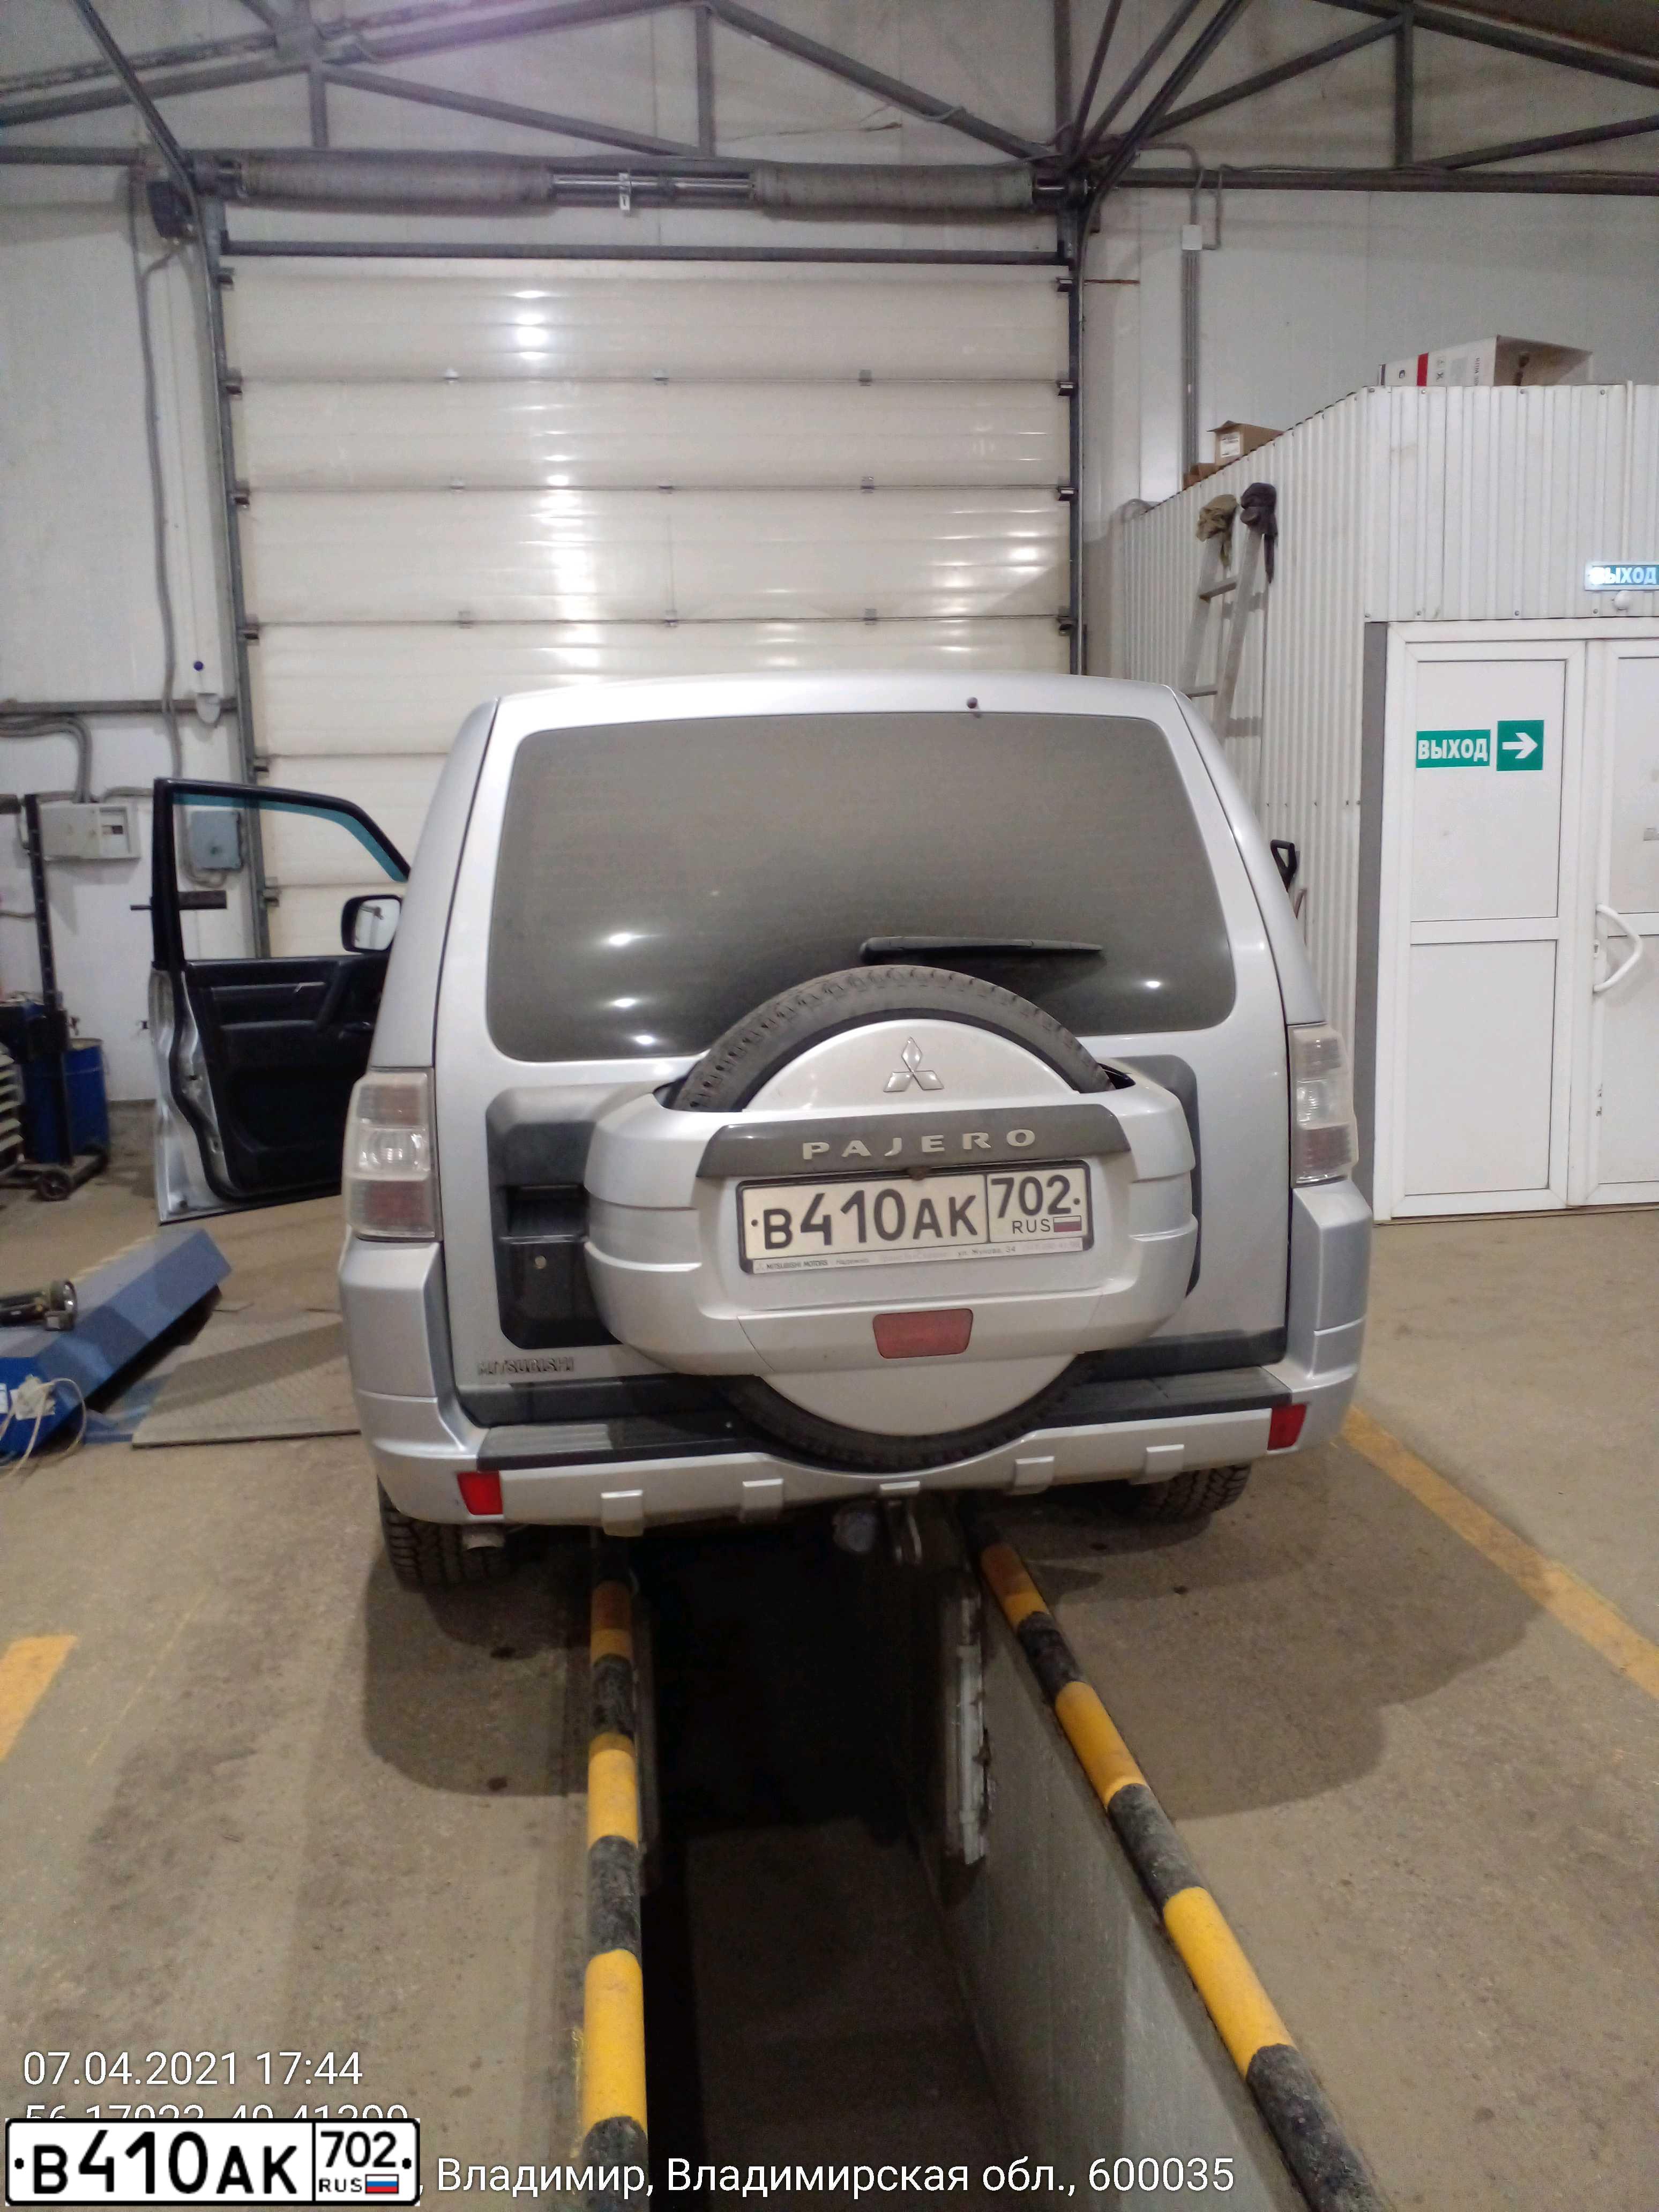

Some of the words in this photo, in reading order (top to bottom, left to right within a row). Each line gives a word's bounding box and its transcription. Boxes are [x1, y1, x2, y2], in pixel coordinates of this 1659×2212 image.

[1590, 566, 1657, 585] ЫХОД
[1417, 738, 1488, 762] ВЫХОД
[802, 1129, 1036, 1160] PAJERO
[762, 1187, 978, 1250] В410АК
[990, 1174, 1073, 1219] 702
[1011, 1218, 1052, 1234] RUS
